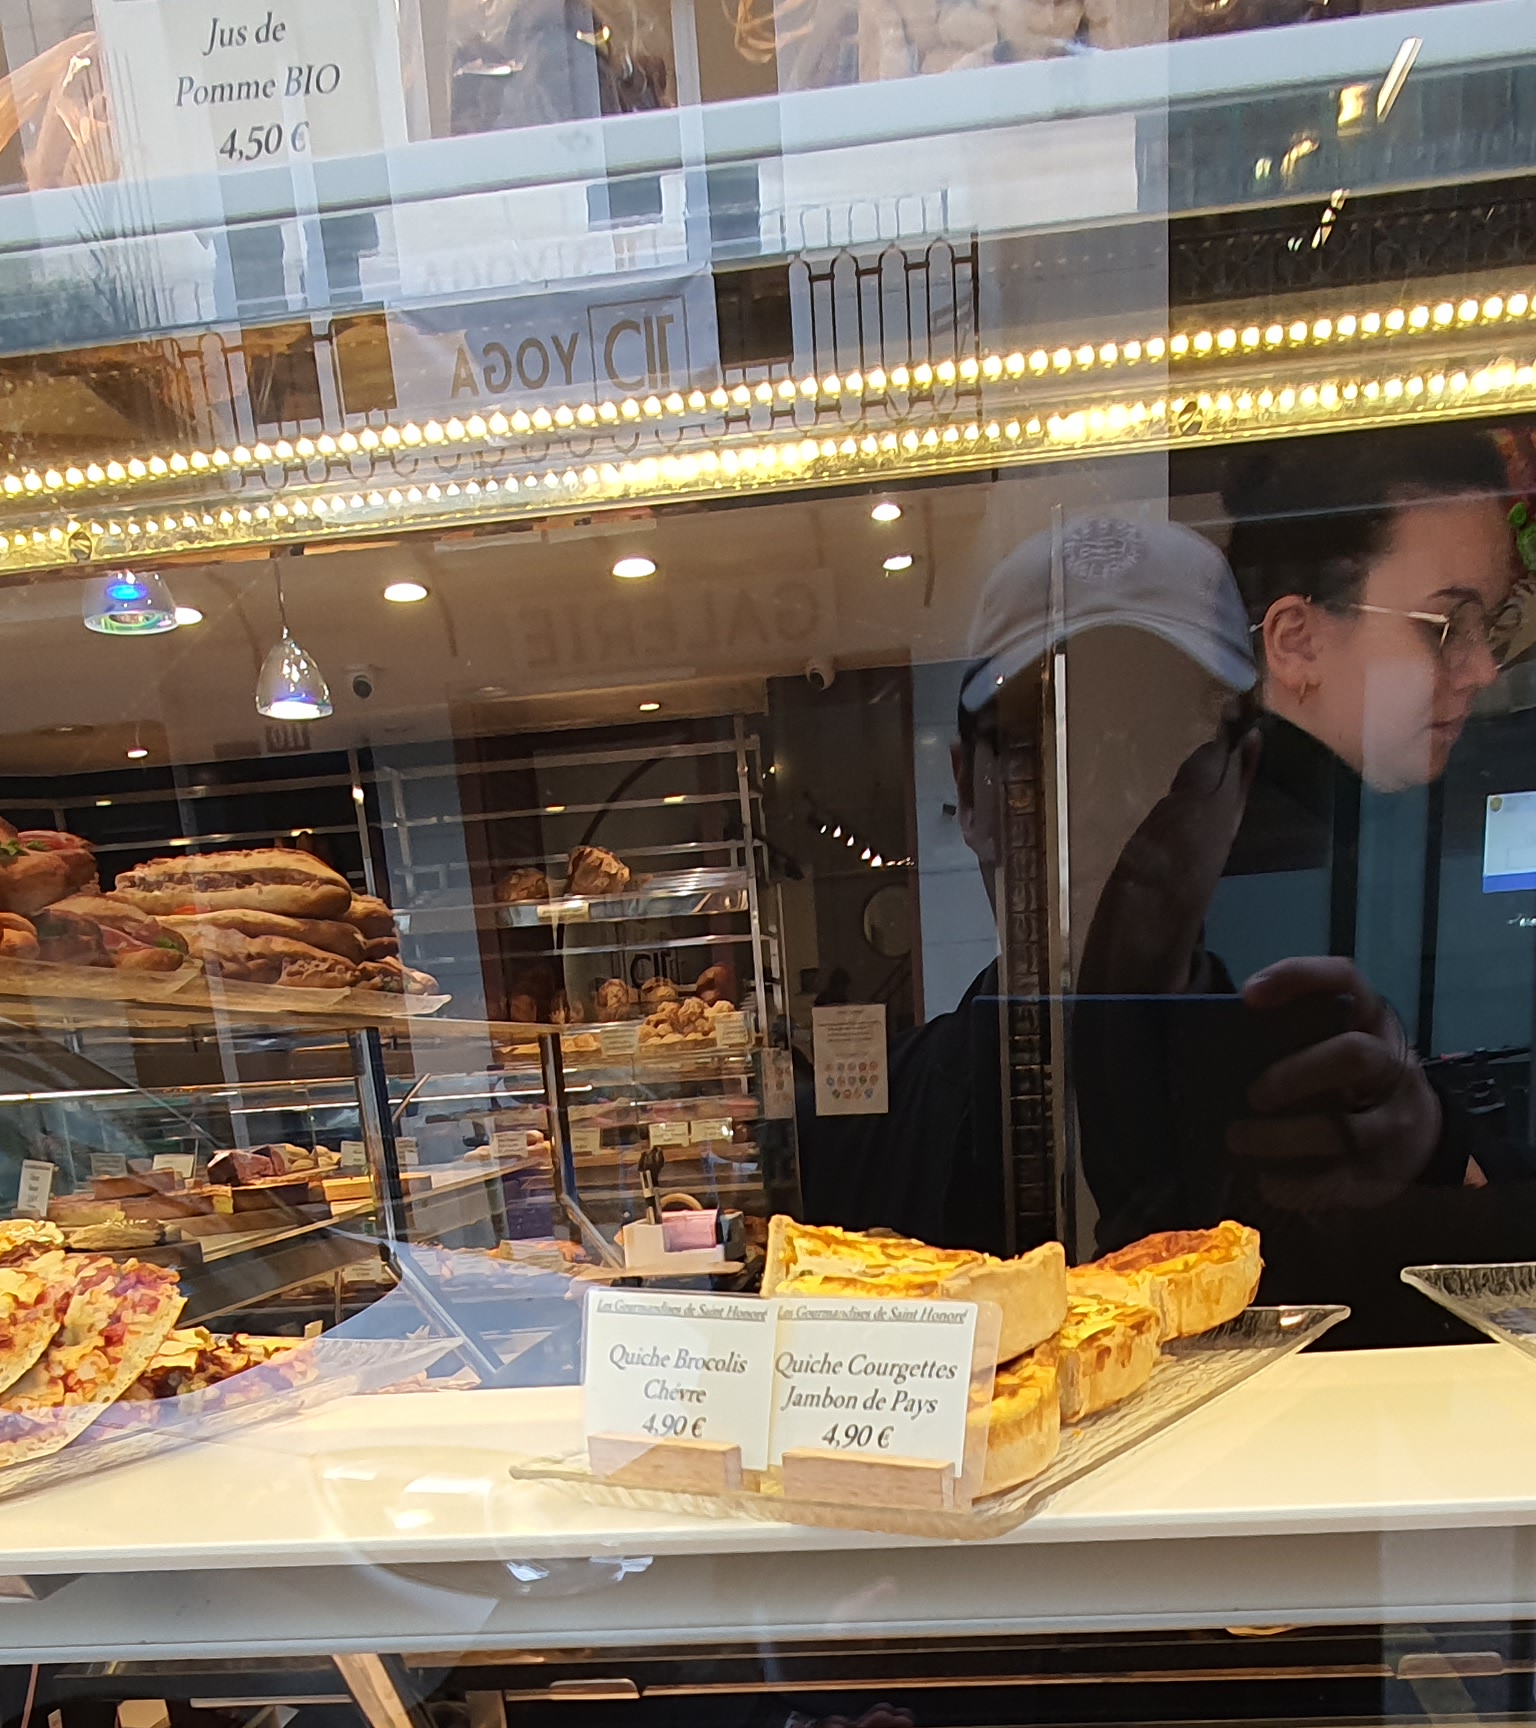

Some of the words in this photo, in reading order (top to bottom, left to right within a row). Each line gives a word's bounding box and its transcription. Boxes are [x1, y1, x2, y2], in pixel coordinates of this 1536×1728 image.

[203, 17, 248, 56] Jus
[255, 11, 286, 44] de
[176, 76, 276, 107] Pomme
[284, 63, 341, 97] BIO
[219, 123, 283, 161] 4,50
[609, 1344, 670, 1371] Quiche
[673, 1348, 748, 1374] Brocolis
[774, 1351, 843, 1379] Quiche
[848, 1354, 958, 1385] Courgettes
[780, 1386, 858, 1411] Jambon
[862, 1388, 887, 1411] de
[890, 1390, 938, 1421] Pays
[642, 1413, 687, 1436] 4,90
[691, 1417, 707, 1438] €
[822, 1423, 873, 1449] 4,90
[877, 1425, 895, 1449] €
